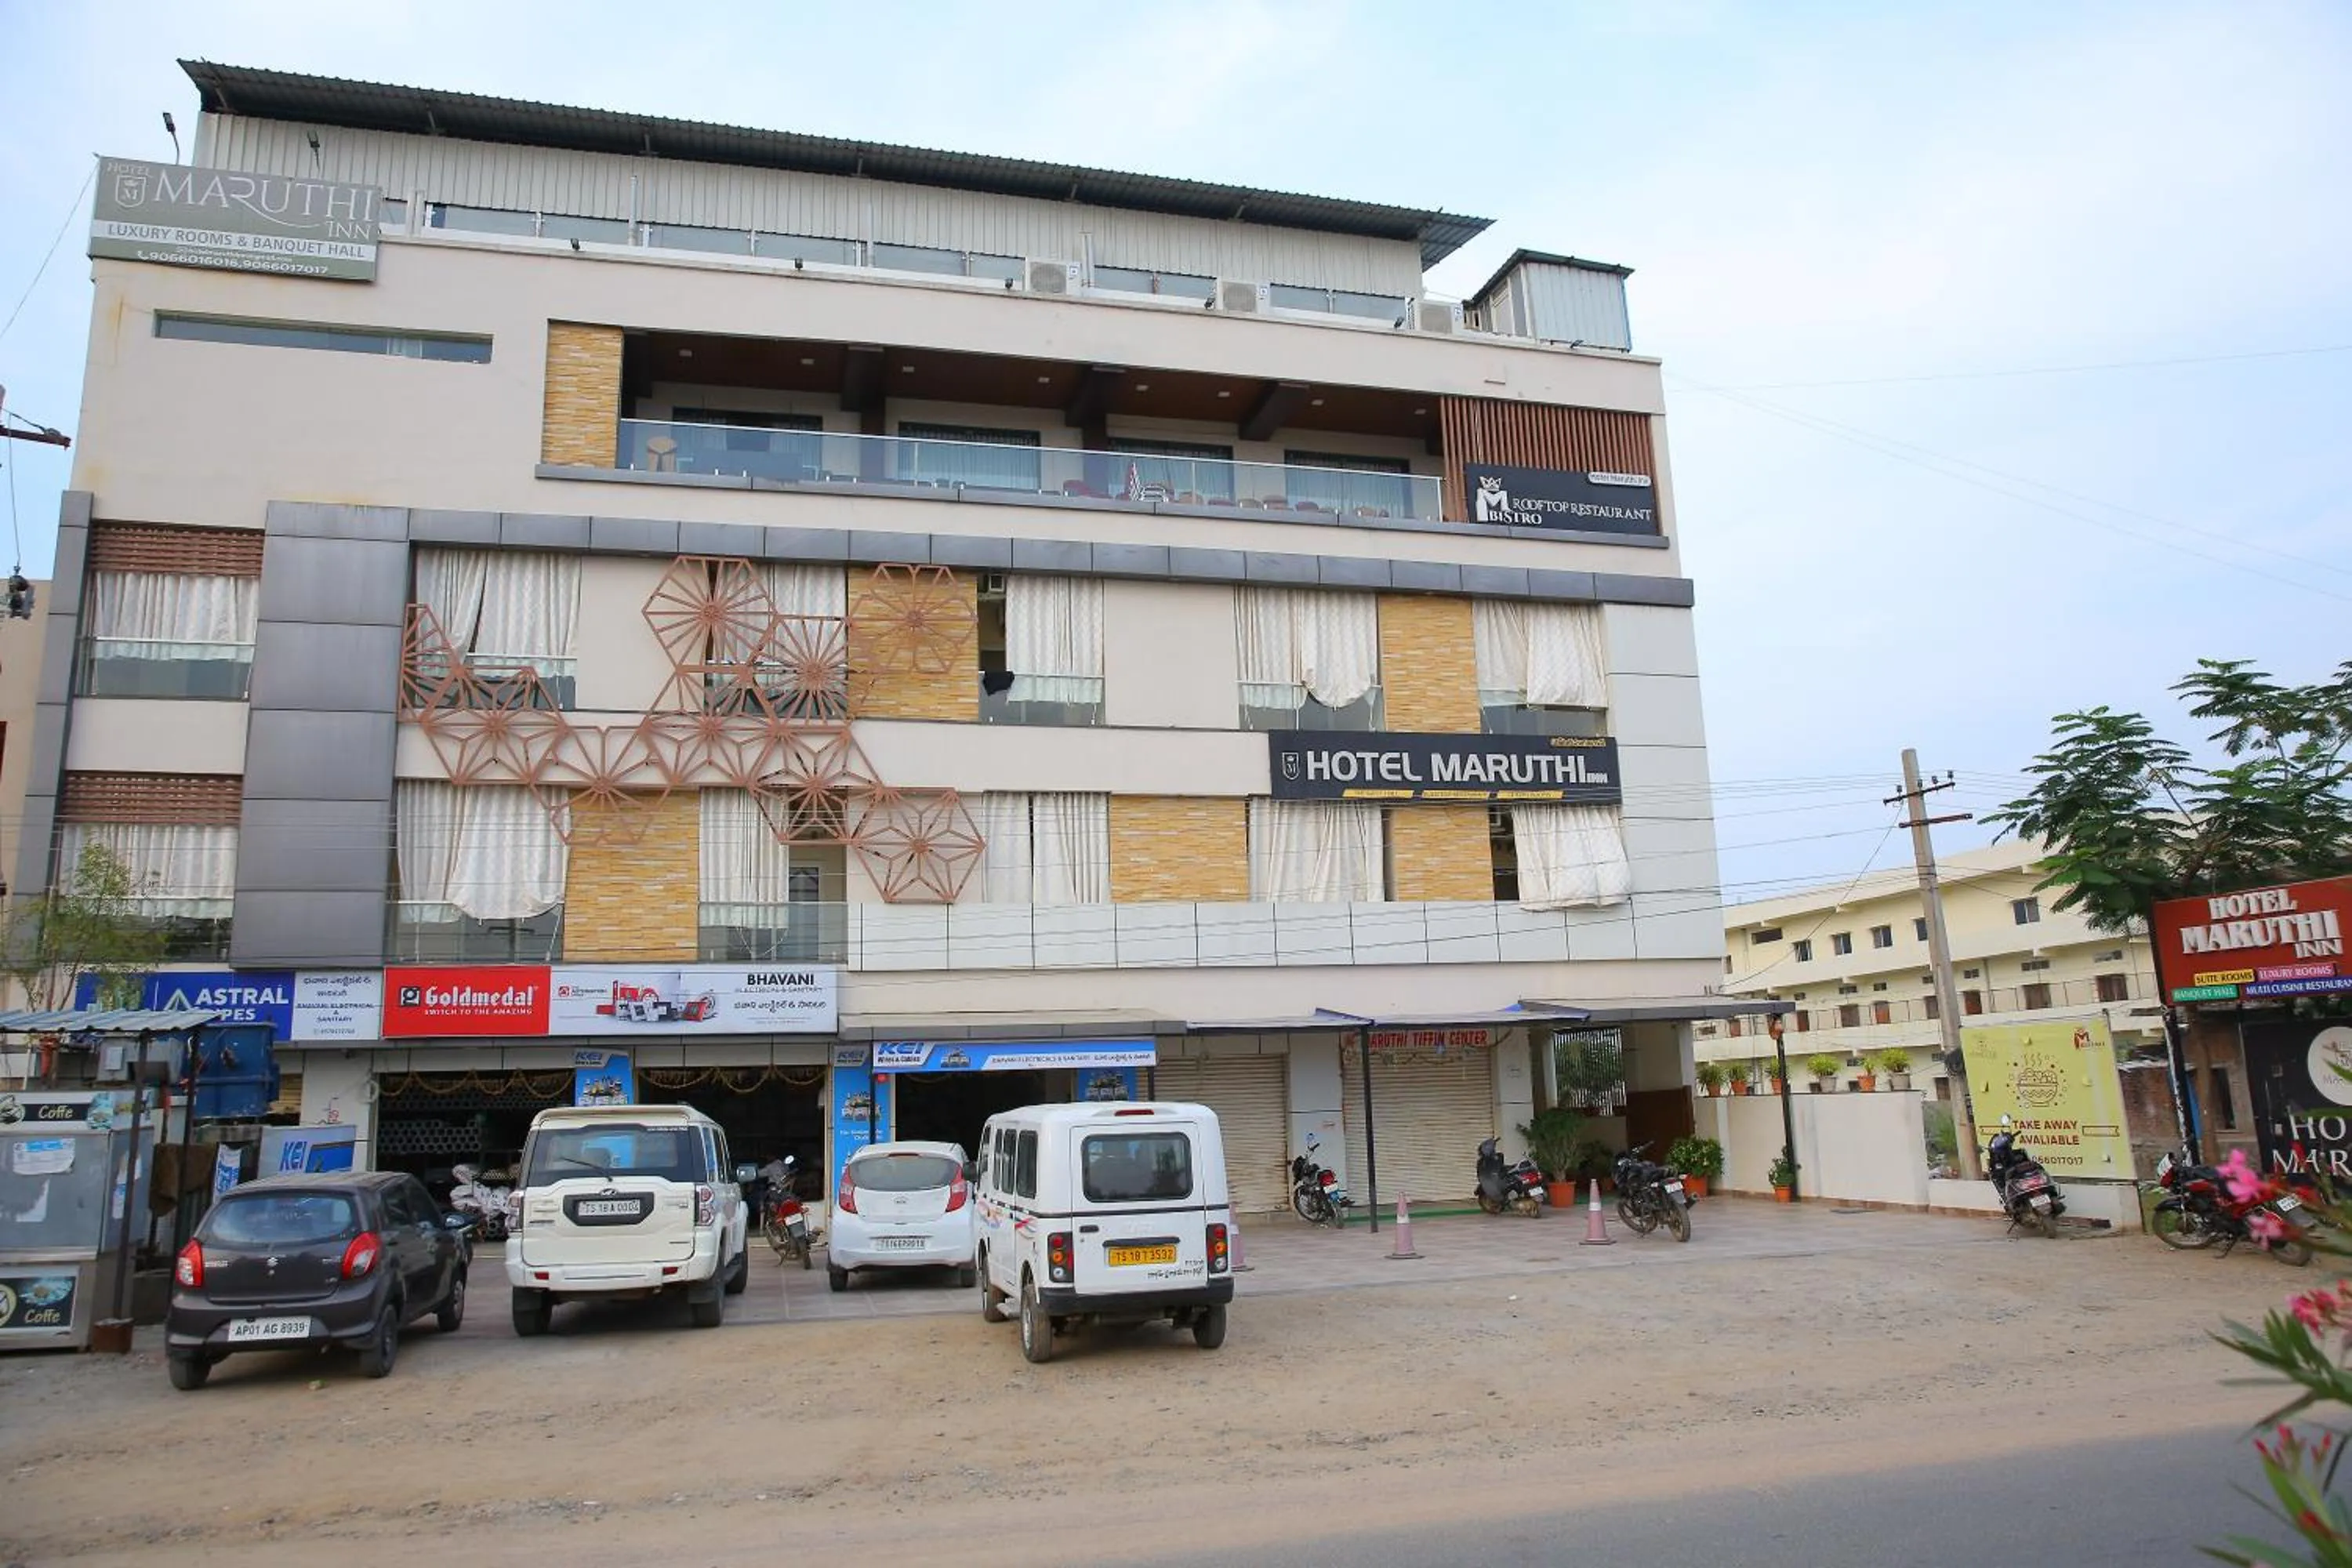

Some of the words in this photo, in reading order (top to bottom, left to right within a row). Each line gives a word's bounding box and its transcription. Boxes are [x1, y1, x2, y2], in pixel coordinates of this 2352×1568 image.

[154, 168, 373, 227] MARUTHI
[325, 220, 372, 241] INN
[107, 223, 171, 241] LUXURY
[175, 229, 233, 247] ROOMS
[237, 234, 249, 246] &
[252, 236, 325, 256] BANQUET
[328, 243, 365, 258] HALL
[1489, 510, 1543, 525] BISTRO
[1513, 498, 1569, 513] ROOFTOP
[1570, 503, 1653, 521] RESTAURANT
[1307, 750, 1423, 782] HOTEL
[1431, 752, 1586, 784] MARUTHI
[2208, 888, 2298, 920] HOTEL
[2180, 909, 2343, 954] MARUTHI
[2294, 938, 2343, 959] INN
[747, 973, 815, 985] BHAVANI
[2196, 973, 2220, 984] SUITE
[2221, 971, 2253, 982] ROOMS
[2258, 967, 2293, 979] LUXURY
[2295, 965, 2333, 976] ROOMS
[2306, 978, 2352, 990] RESTAURAN
[196, 986, 289, 1005] ASTRAL
[425, 985, 533, 1007] Goldmedal
[878, 1041, 924, 1054] KEI
[1368, 1032, 1408, 1048] ARUTHI
[1412, 1031, 1446, 1047] TIFFIN
[1450, 1029, 1488, 1046] CENTER
[38, 1104, 74, 1120] Coffe
[2013, 1120, 2041, 1130] TAKE
[2044, 1120, 2078, 1130] AWAY
[2286, 1105, 2347, 1141] HO
[2019, 1134, 2080, 1145] AVALIABLE
[279, 1141, 308, 1172] KEI
[2031, 1156, 2083, 1165] 066017017
[2272, 1149, 2352, 1177] MAR
[24, 1308, 60, 1324] Coffe
[235, 1325, 260, 1336] AP01
[263, 1323, 278, 1334] AG
